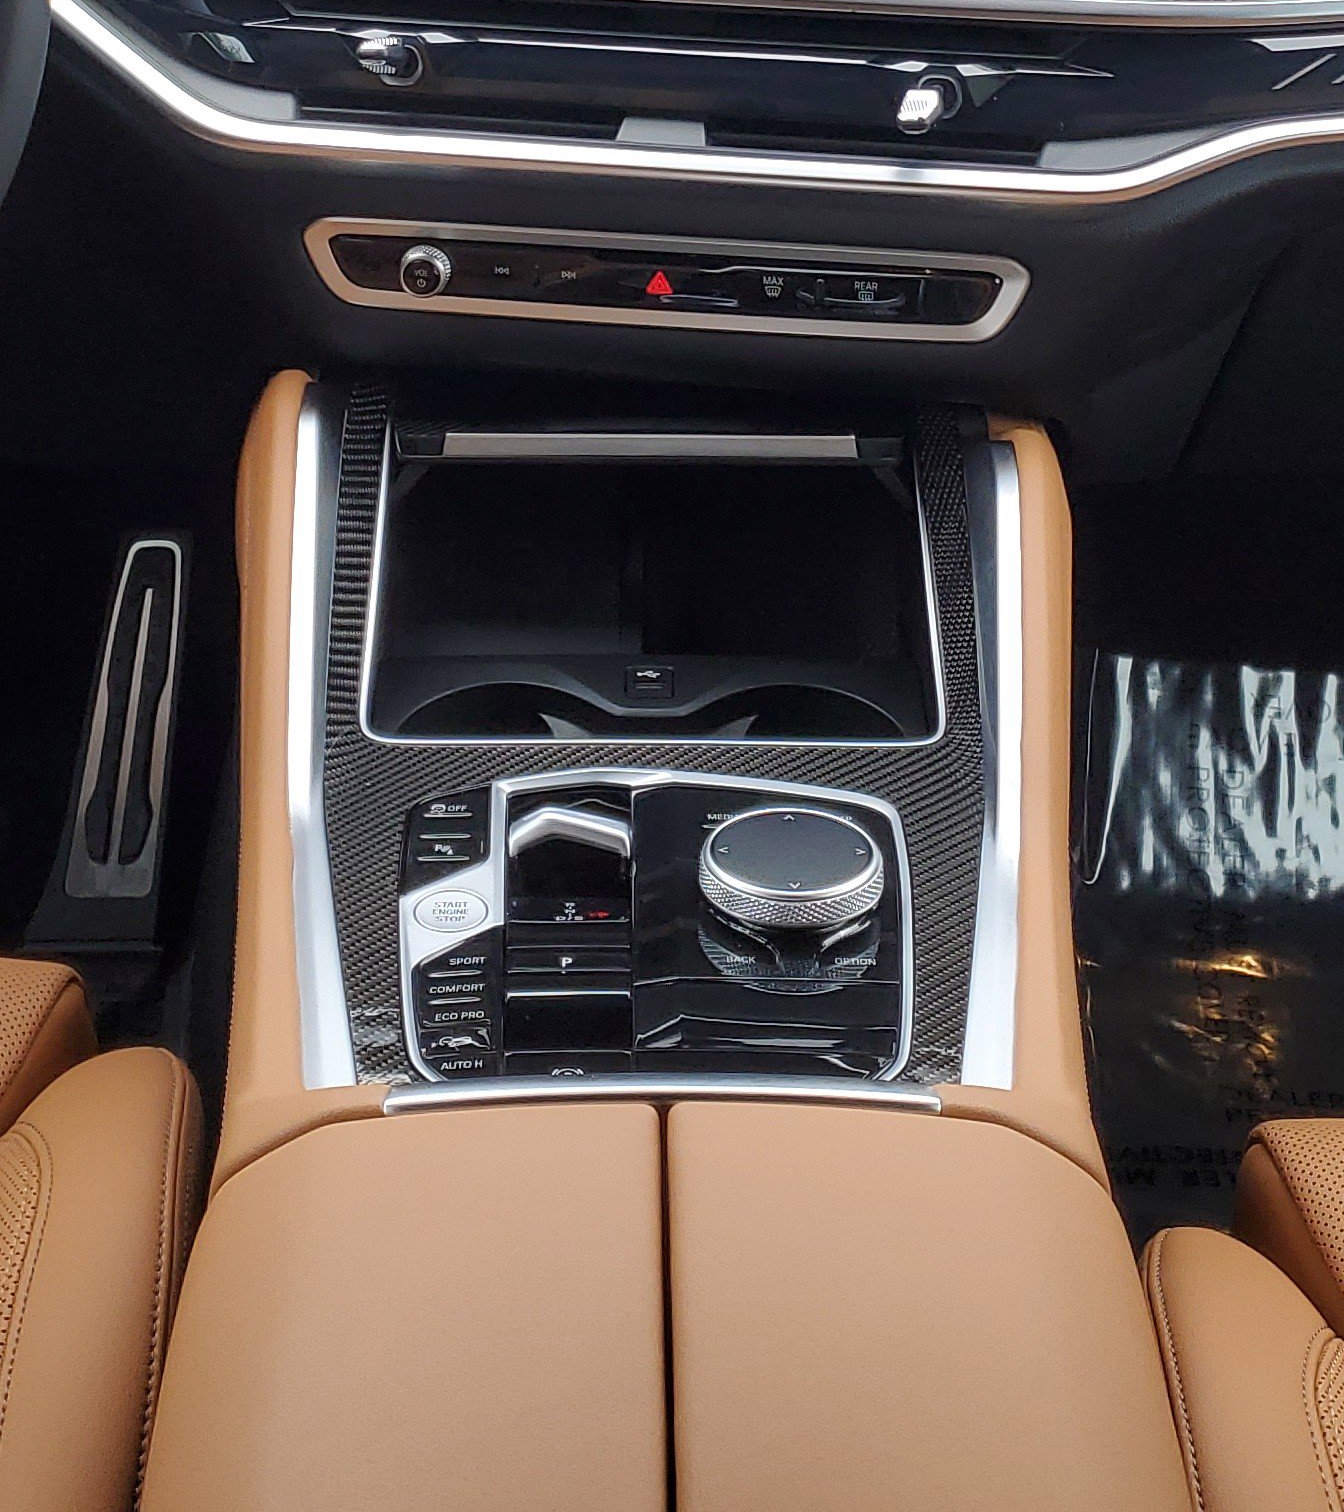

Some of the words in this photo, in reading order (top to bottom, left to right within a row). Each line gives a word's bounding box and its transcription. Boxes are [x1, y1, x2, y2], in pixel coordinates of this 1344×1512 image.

[763, 275, 784, 286] MAX
[854, 281, 879, 291] REAR
[448, 804, 468, 812] OFF
[449, 956, 487, 966] SPORT
[561, 957, 573, 968] P
[726, 956, 756, 964] BACK
[834, 957, 877, 966] OPTION
[429, 984, 487, 994] COMFORT
[435, 1012, 458, 1022] ECO
[461, 1011, 485, 1020] PRO
[440, 1061, 472, 1071] AUTO
